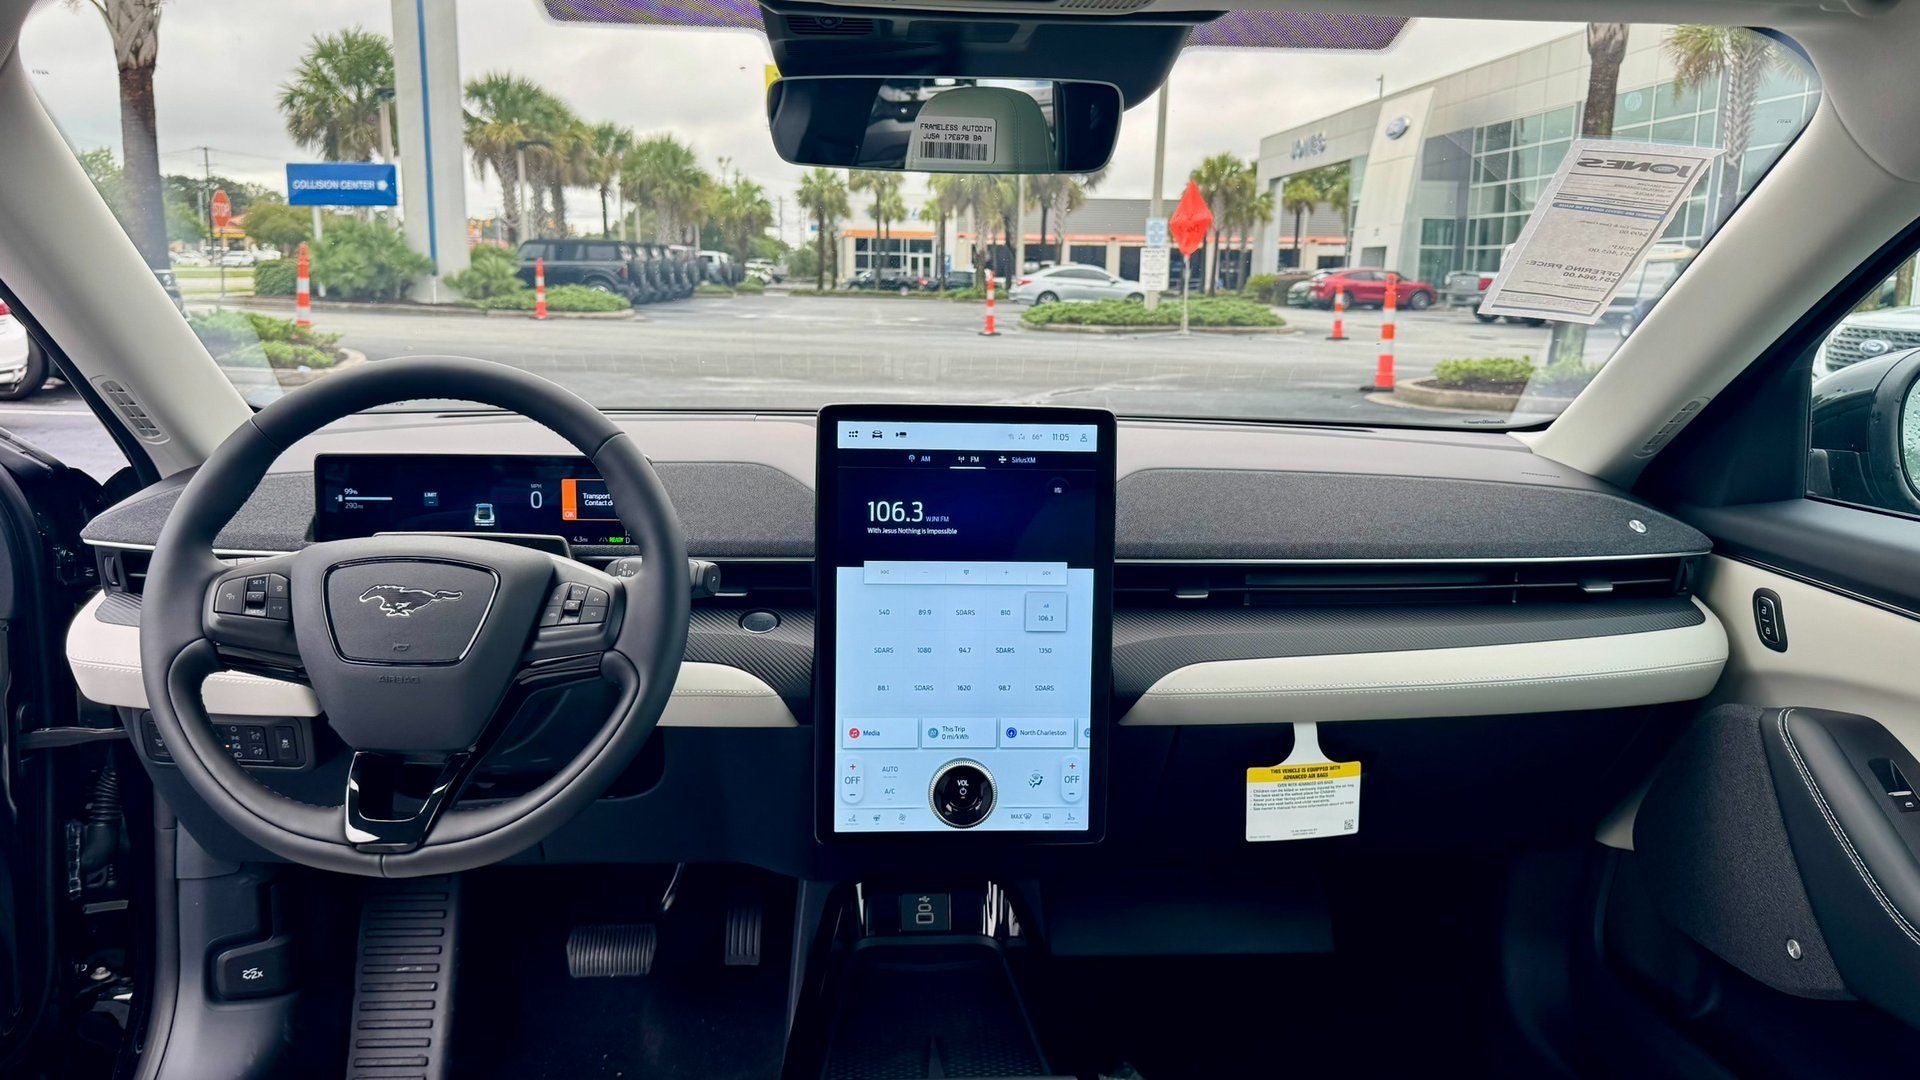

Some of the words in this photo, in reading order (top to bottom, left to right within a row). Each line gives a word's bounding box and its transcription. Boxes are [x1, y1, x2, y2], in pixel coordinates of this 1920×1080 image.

[920, 122, 958, 131] FRAMELESS
[292, 180, 339, 190] COLLISION
[340, 180, 375, 190] CENTER
[213, 202, 230, 217] STOP
[1052, 433, 1070, 441] 11:05
[1011, 456, 1036, 464] SiriusXM
[530, 491, 542, 509] 0
[868, 501, 923, 522] 106.3
